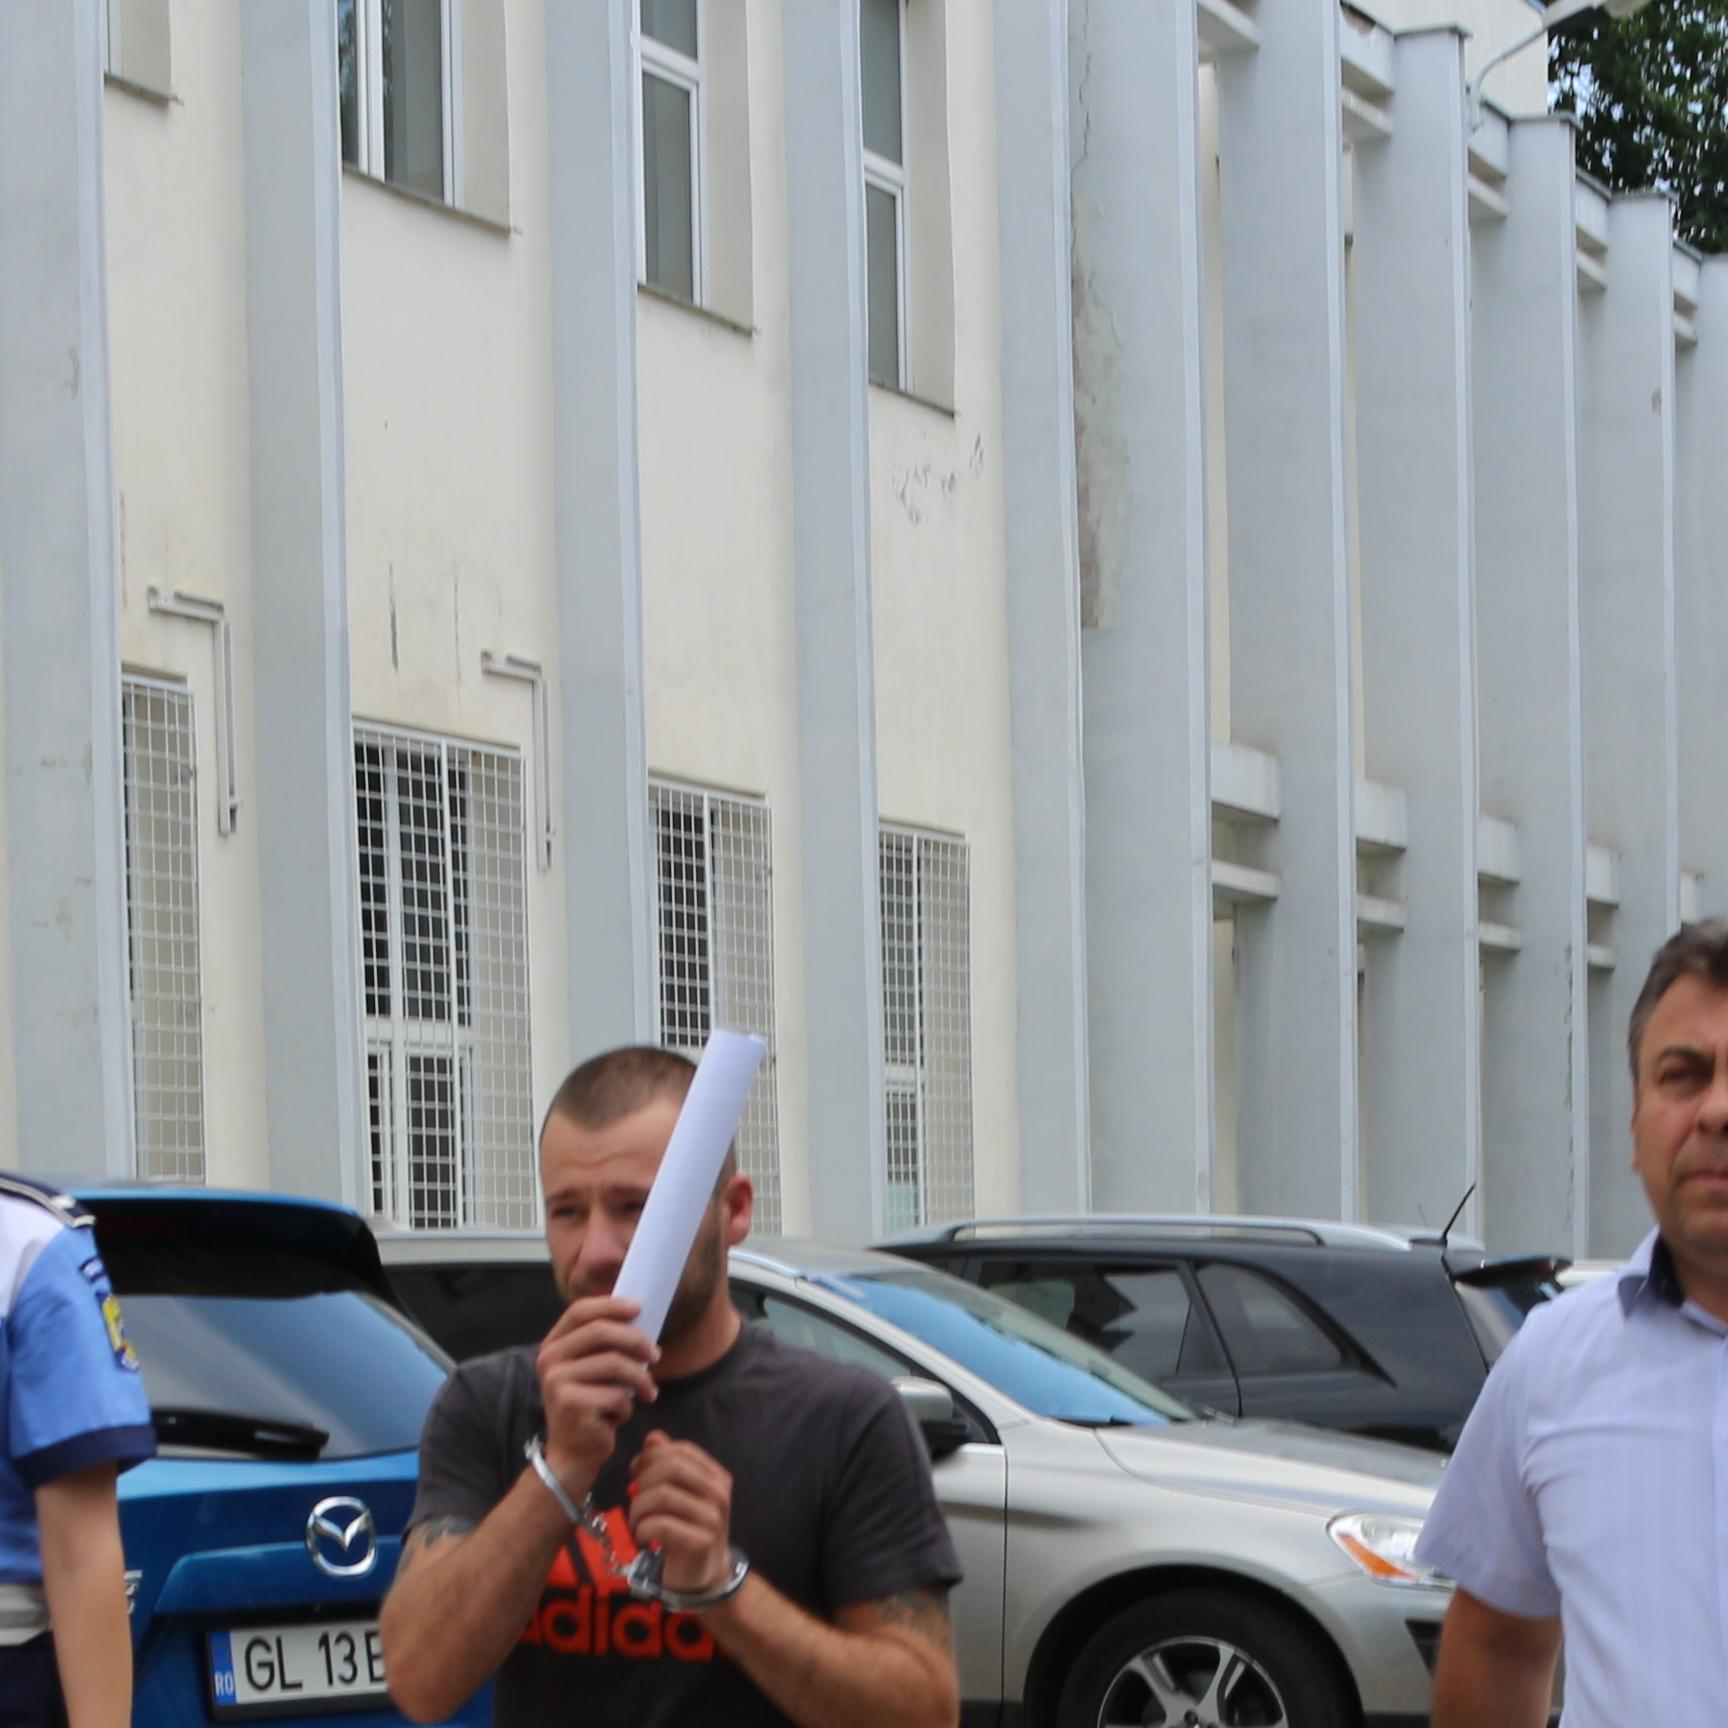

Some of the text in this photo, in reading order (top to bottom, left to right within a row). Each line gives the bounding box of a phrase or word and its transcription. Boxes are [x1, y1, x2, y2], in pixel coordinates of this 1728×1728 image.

[521, 1584, 729, 1664] dida
[215, 1671, 234, 1697] RO
[245, 1638, 303, 1692] GL
